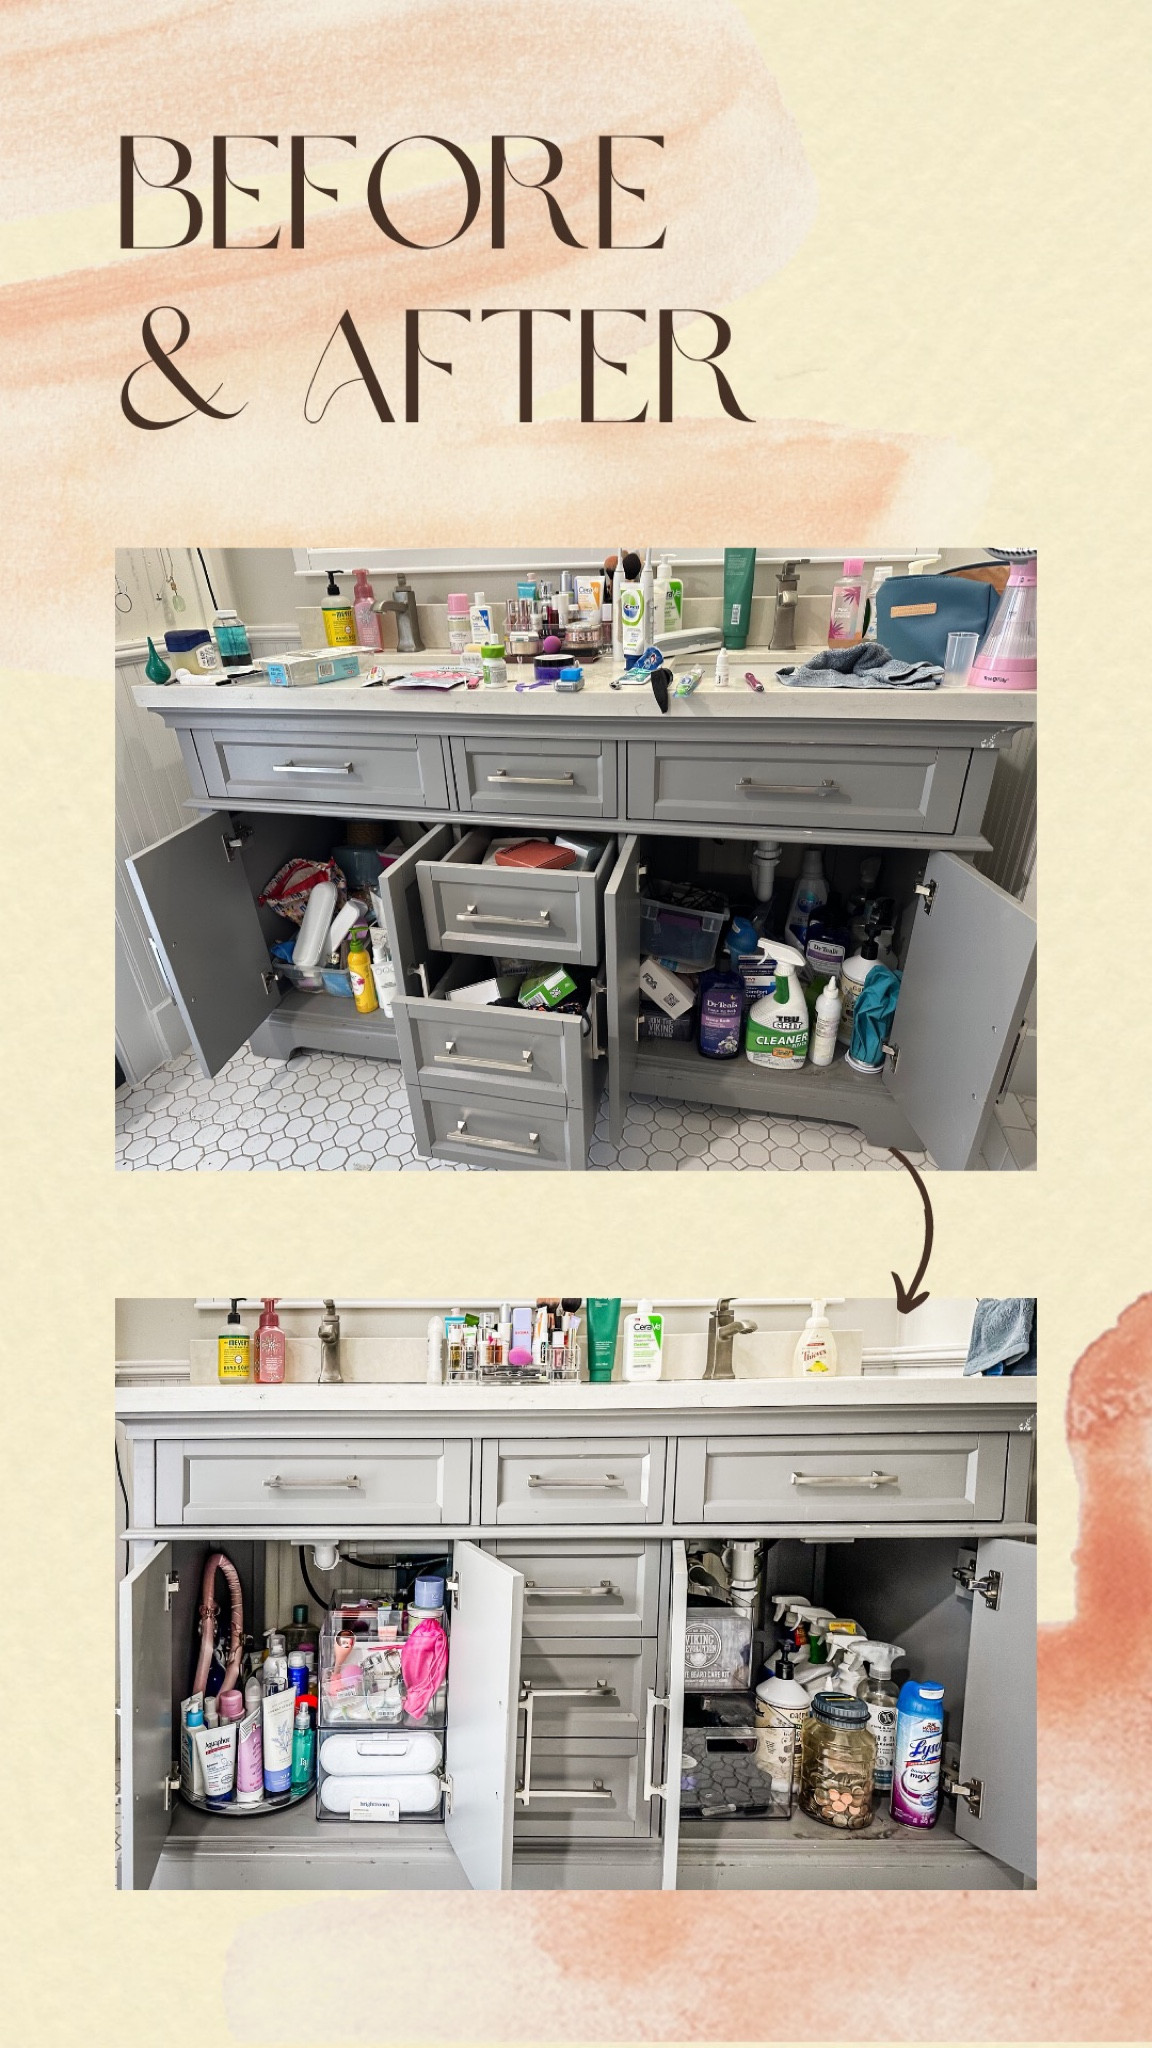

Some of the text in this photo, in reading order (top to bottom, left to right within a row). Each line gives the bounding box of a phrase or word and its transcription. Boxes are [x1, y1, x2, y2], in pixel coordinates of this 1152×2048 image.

[707, 1000, 718, 1008] Dr
[649, 1023, 674, 1033] VIKING
[773, 1022, 802, 1030] GRIT
[756, 1032, 809, 1046] CLEANER
[633, 1323, 661, 1331] CeraVe
[686, 1634, 714, 1645] VIKING
[204, 1737, 230, 1750] Aquaphor
